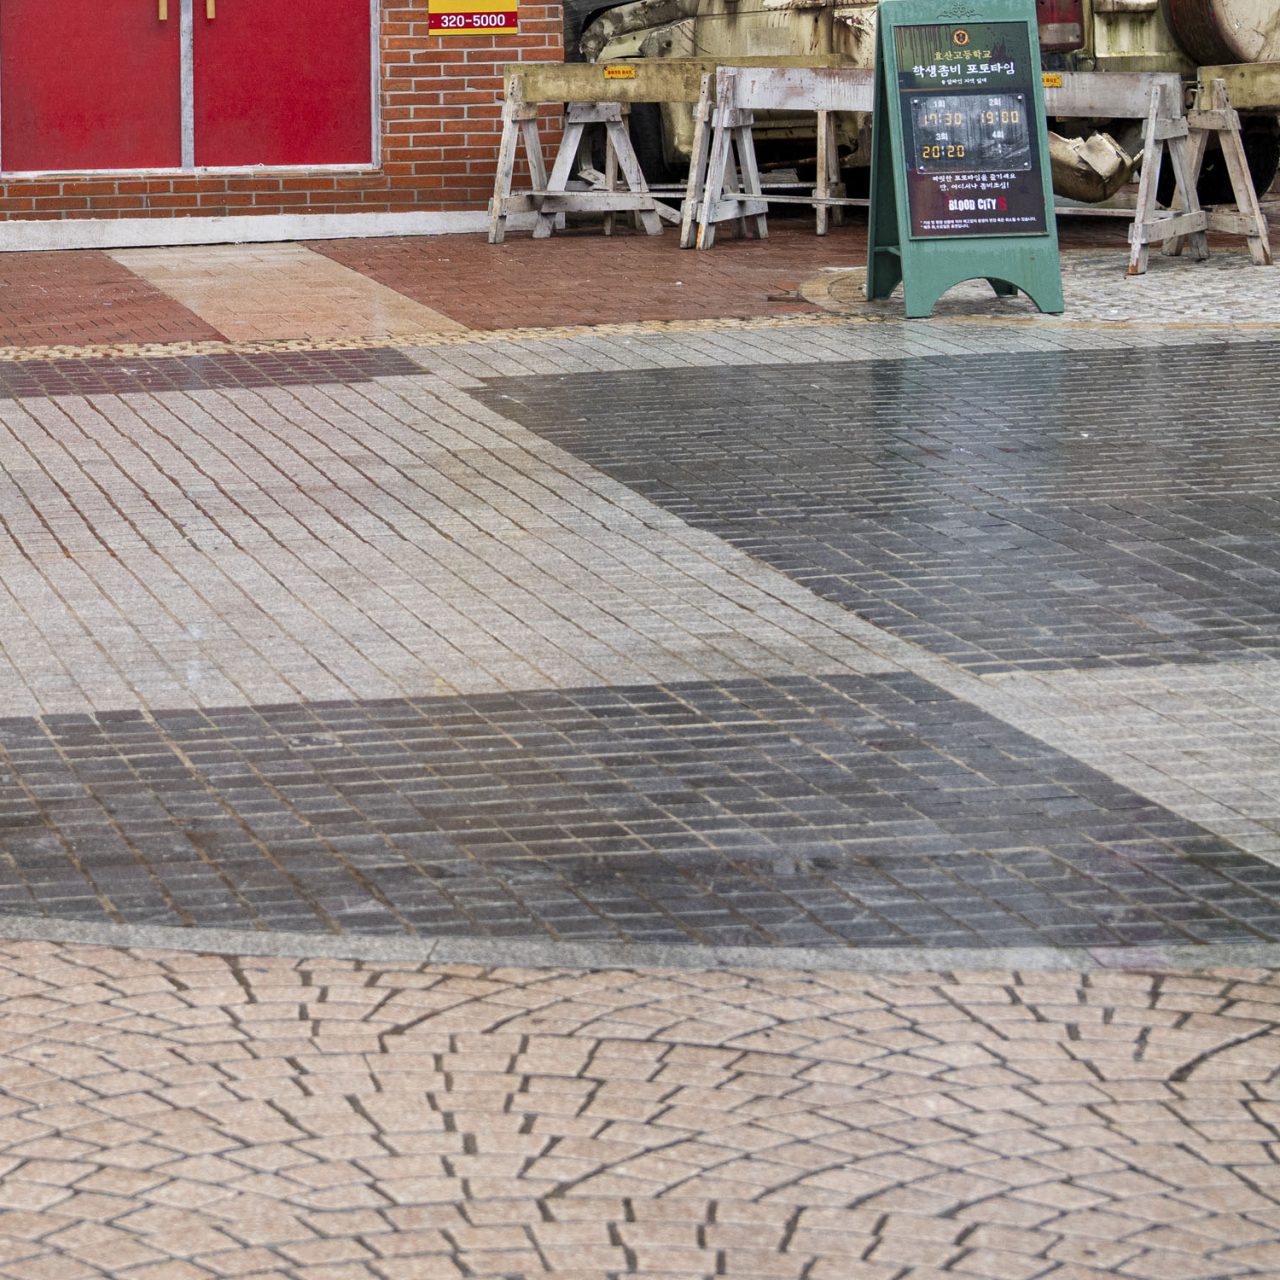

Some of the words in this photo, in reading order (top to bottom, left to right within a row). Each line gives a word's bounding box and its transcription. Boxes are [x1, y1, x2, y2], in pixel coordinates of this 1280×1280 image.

[441, 15, 506, 27] 320-5000
[934, 50, 992, 61] 효산고등학교
[912, 64, 961, 78] 학생좀비
[966, 62, 1015, 75] 포토타임
[981, 111, 1019, 124] 19:00
[923, 145, 965, 158] 20:20
[949, 199, 975, 211] BLOOD
[978, 198, 996, 210] CITY
